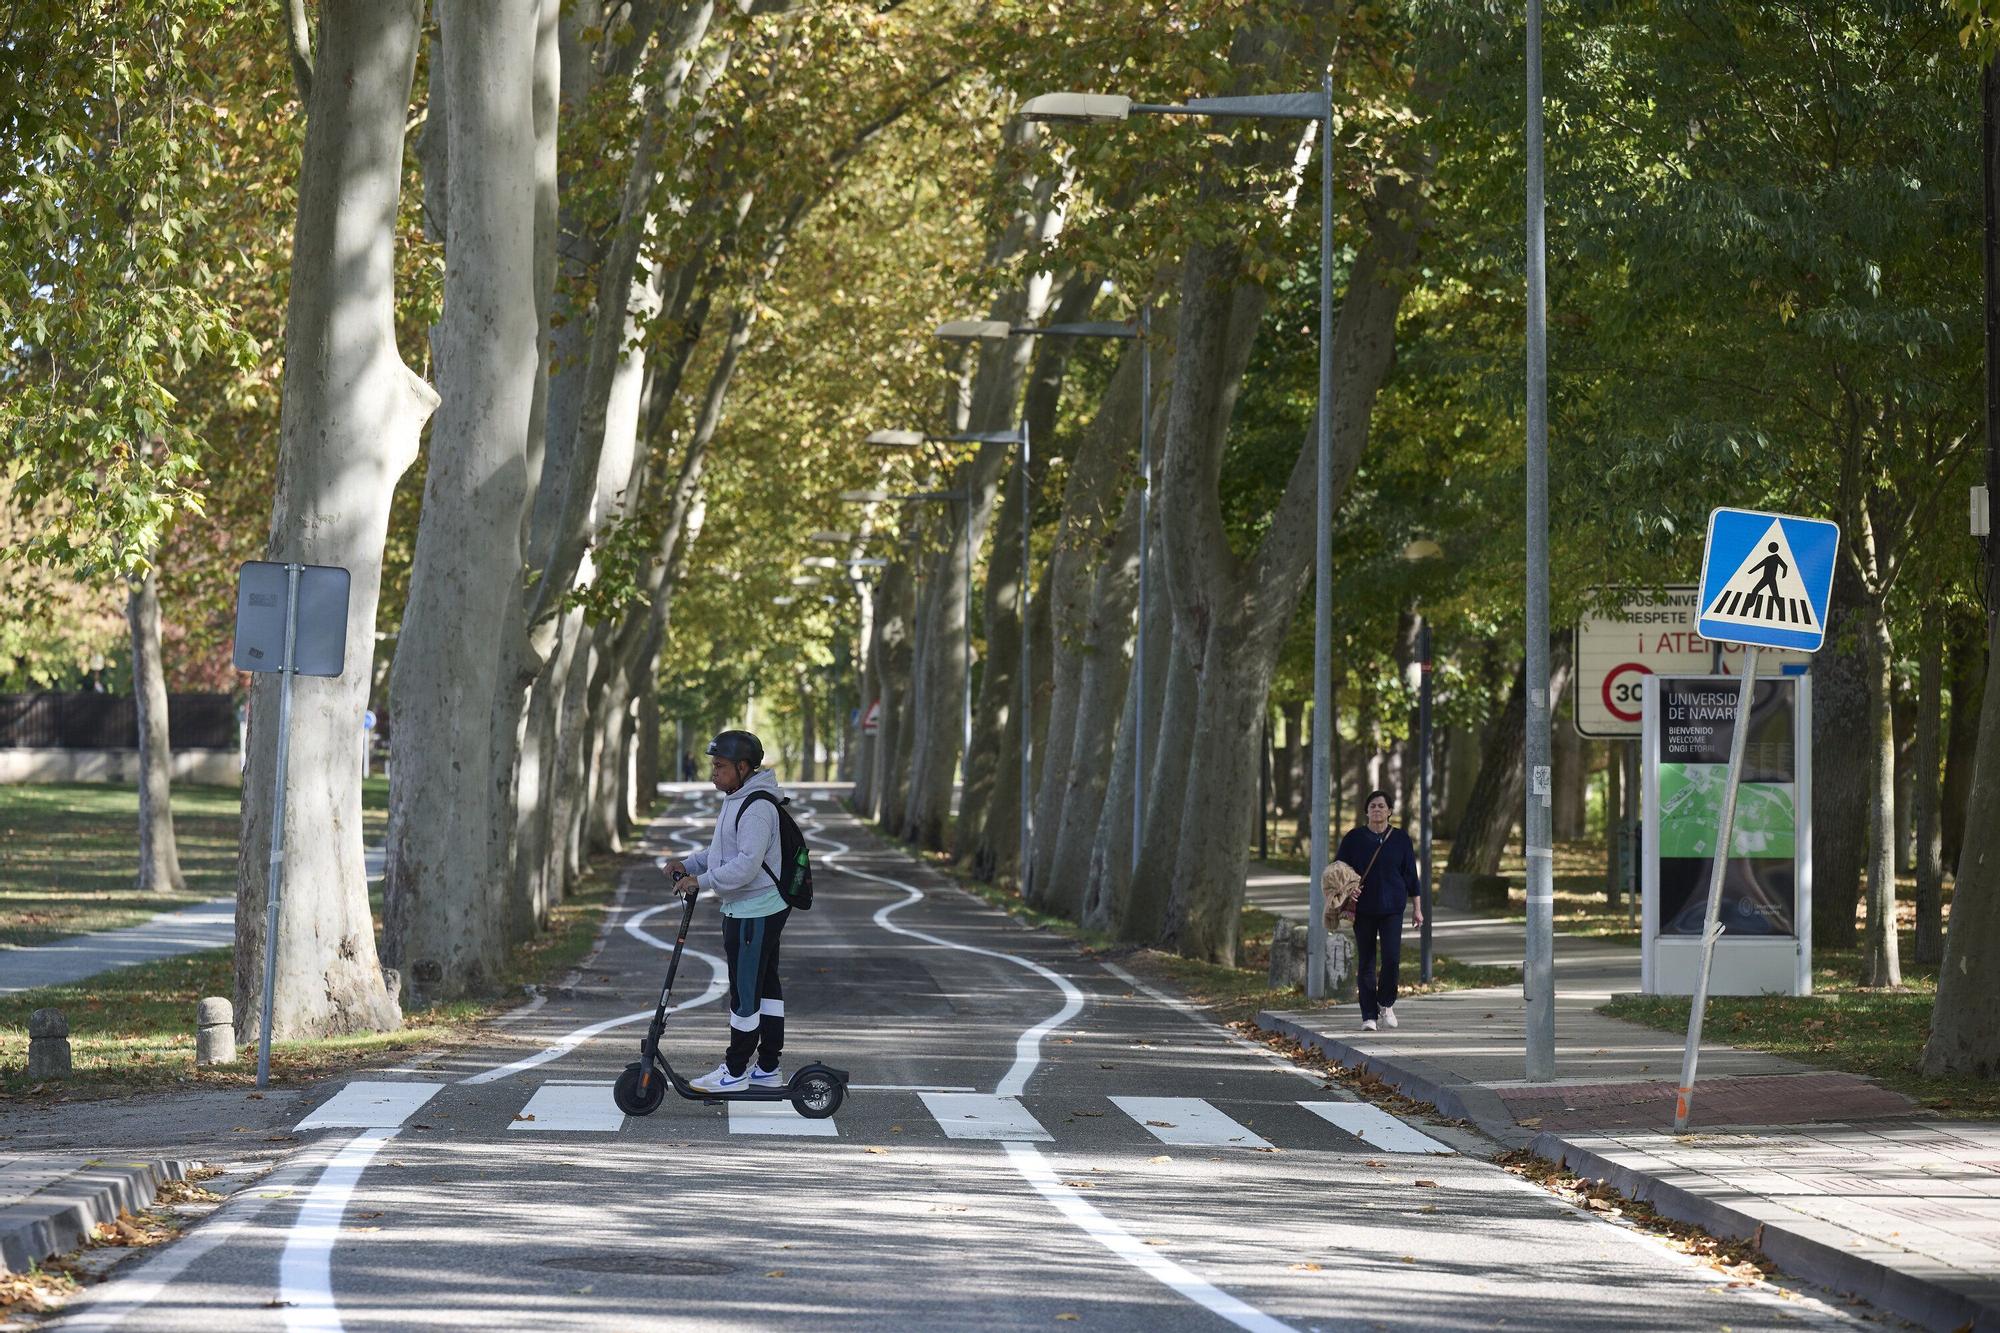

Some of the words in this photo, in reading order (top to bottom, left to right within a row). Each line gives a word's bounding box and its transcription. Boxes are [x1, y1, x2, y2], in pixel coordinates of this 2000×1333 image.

[1668, 707, 1685, 720] DE
[1668, 726, 1714, 735] BIENVENIDO
[1668, 735, 1706, 744] WELCOME
[1668, 744, 1688, 753] ONGI
